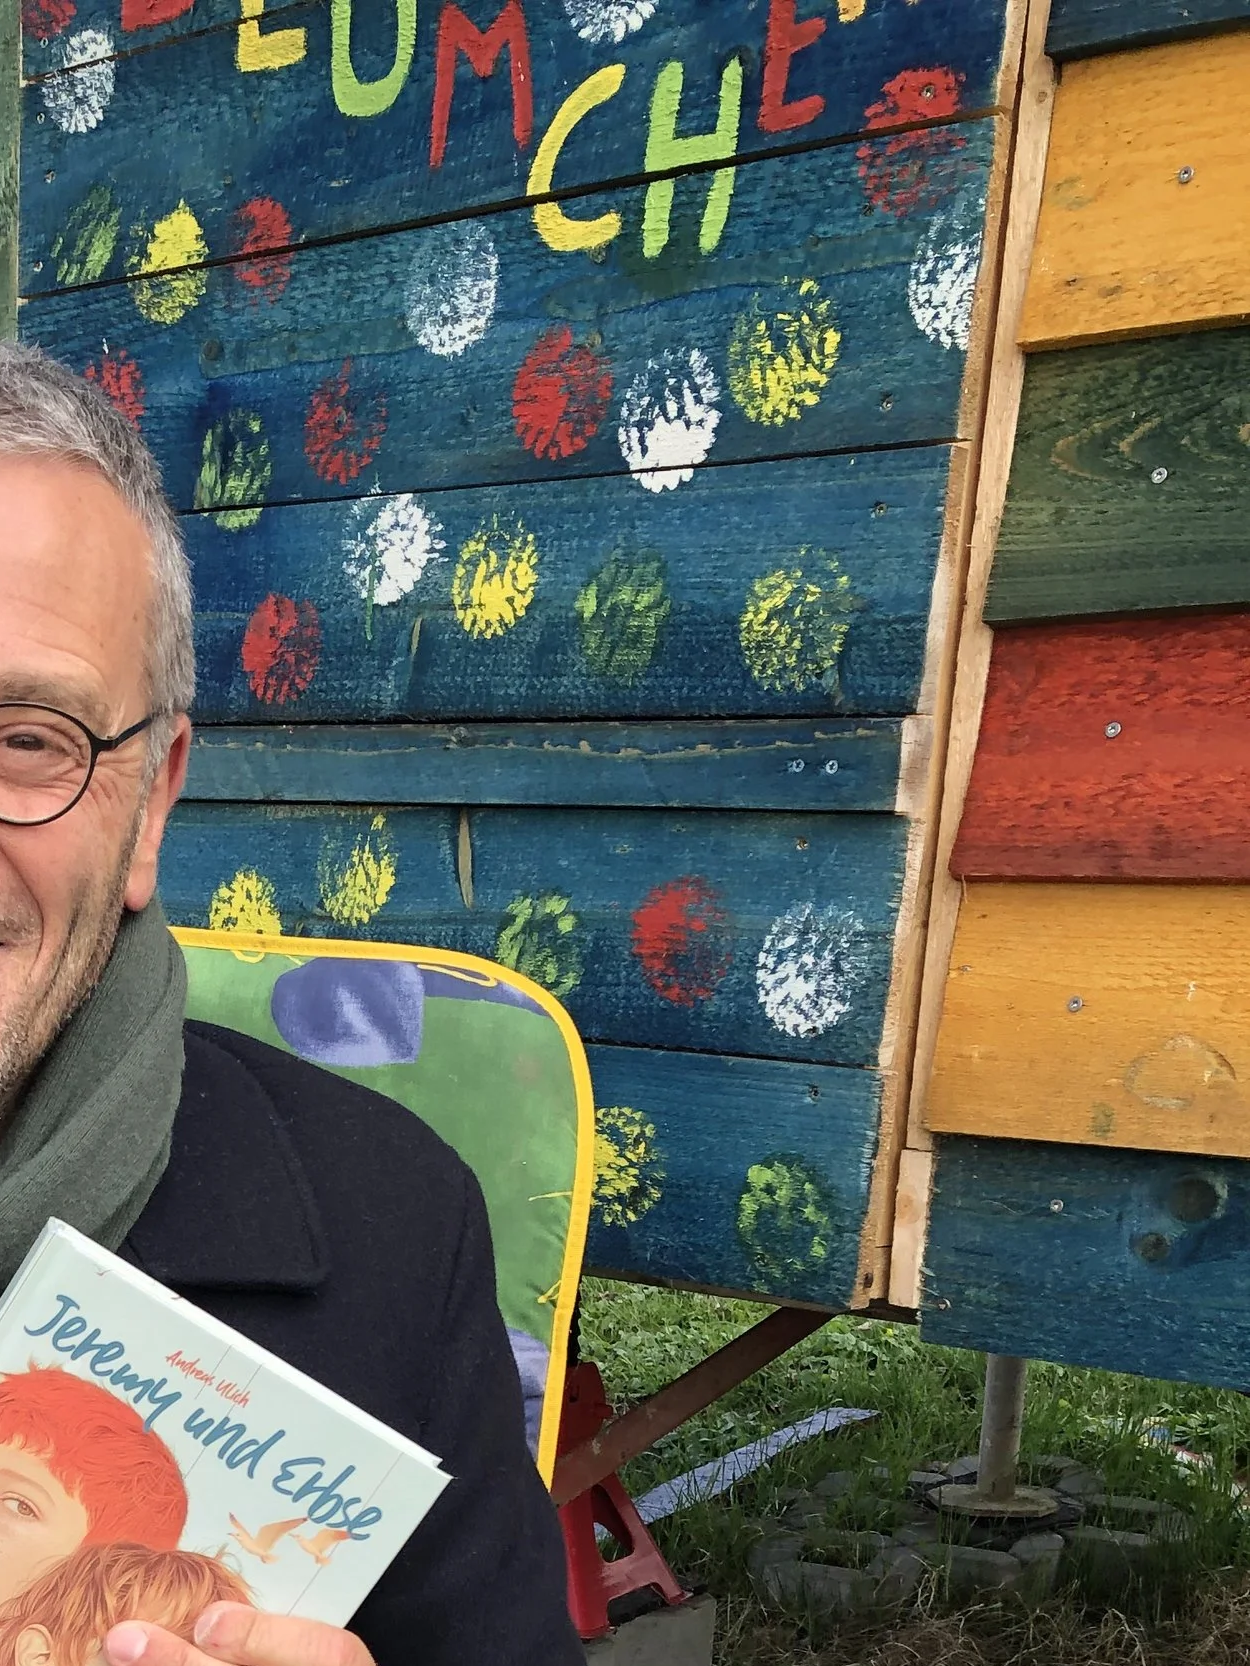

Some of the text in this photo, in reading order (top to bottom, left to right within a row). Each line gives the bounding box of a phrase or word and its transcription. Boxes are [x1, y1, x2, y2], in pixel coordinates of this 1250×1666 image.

[23, 1294, 383, 1541] Jeremy und Erbse
[165, 1350, 216, 1387] Andreas
